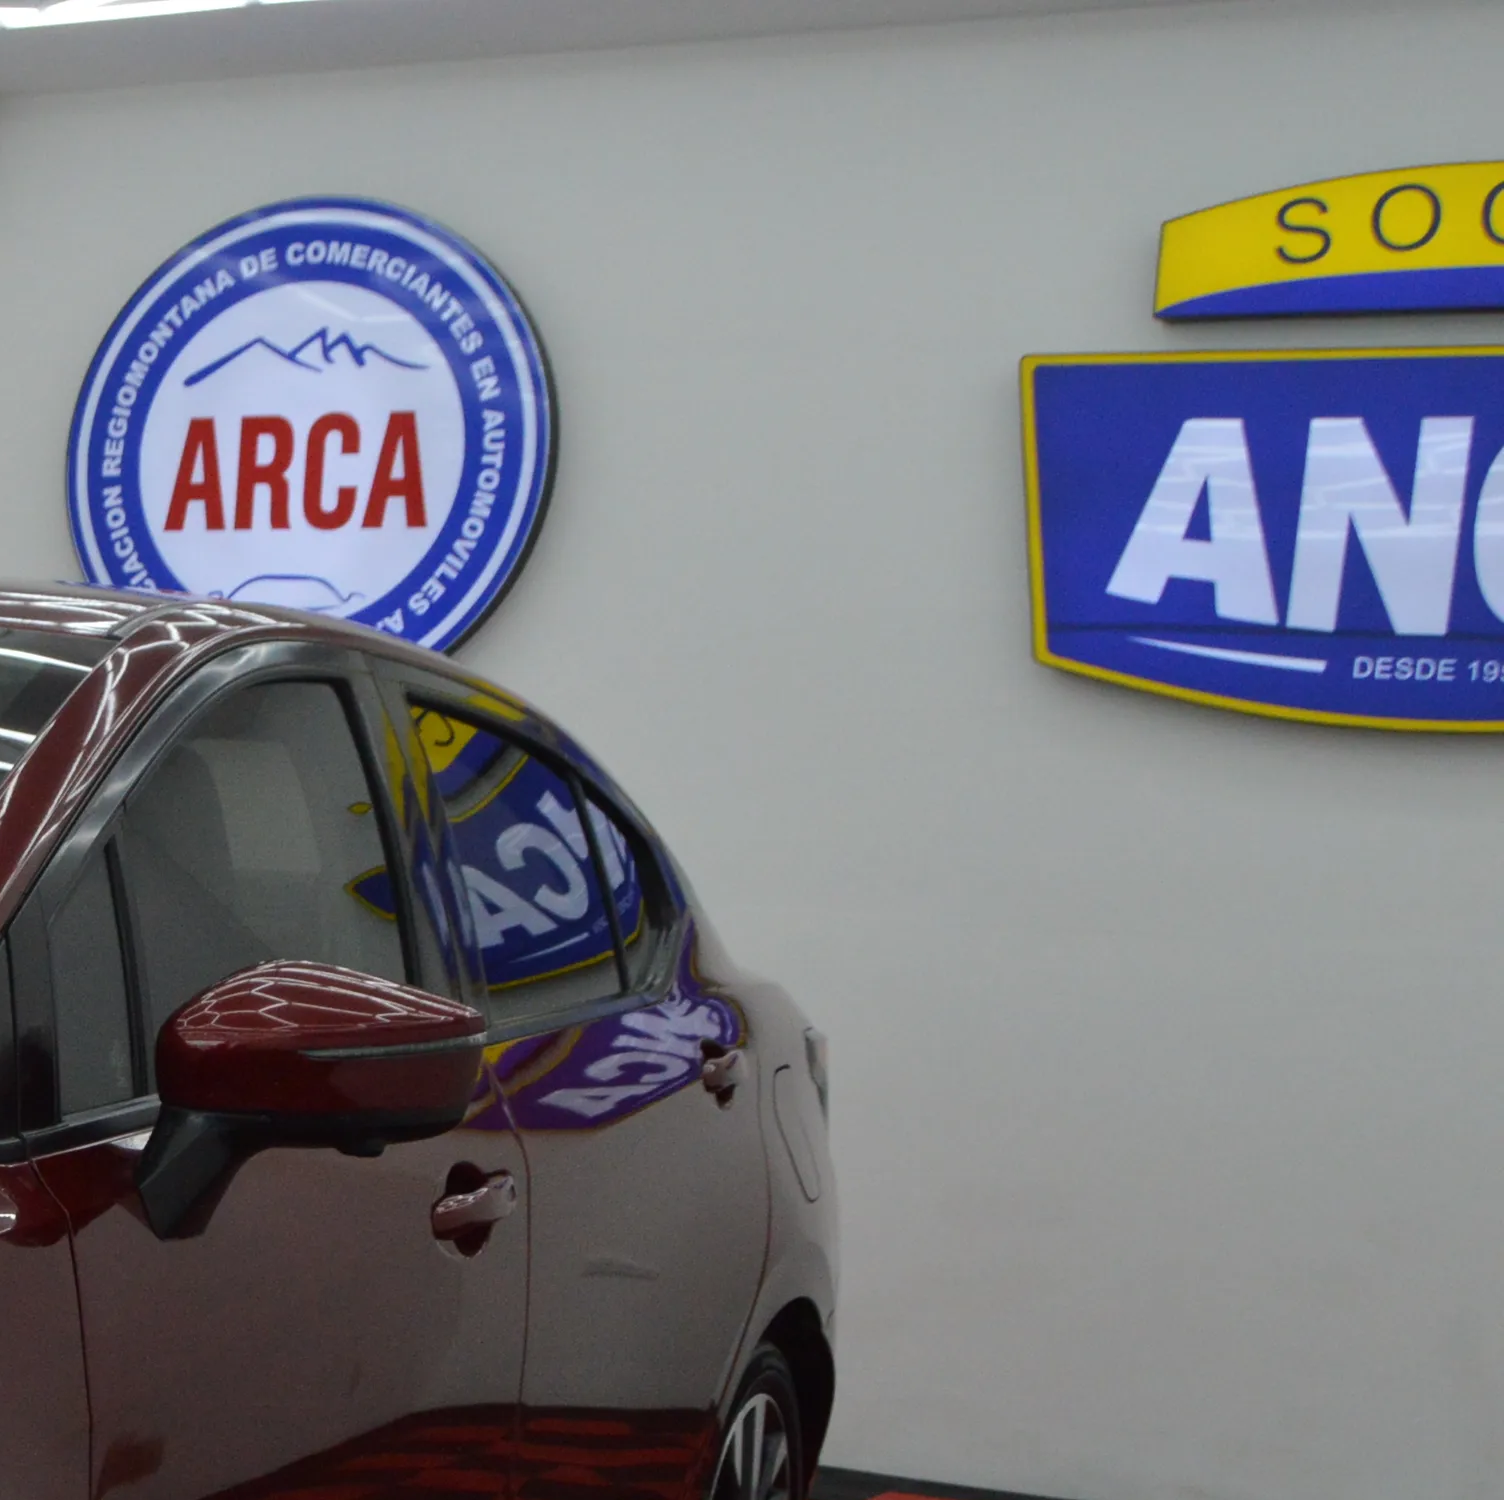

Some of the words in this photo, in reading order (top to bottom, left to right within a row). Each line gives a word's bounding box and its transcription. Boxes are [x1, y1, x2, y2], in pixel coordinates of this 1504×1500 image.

[239, 247, 279, 279] DE
[285, 240, 484, 354] COMERCIANTES
[101, 270, 233, 478] REGIOMONTANA
[470, 356, 501, 401] EN
[163, 410, 428, 532] ARCA
[408, 408, 507, 616] AUTOMOVILES
[1352, 655, 1458, 682] DESDE
[1467, 659, 1504, 683] 19
